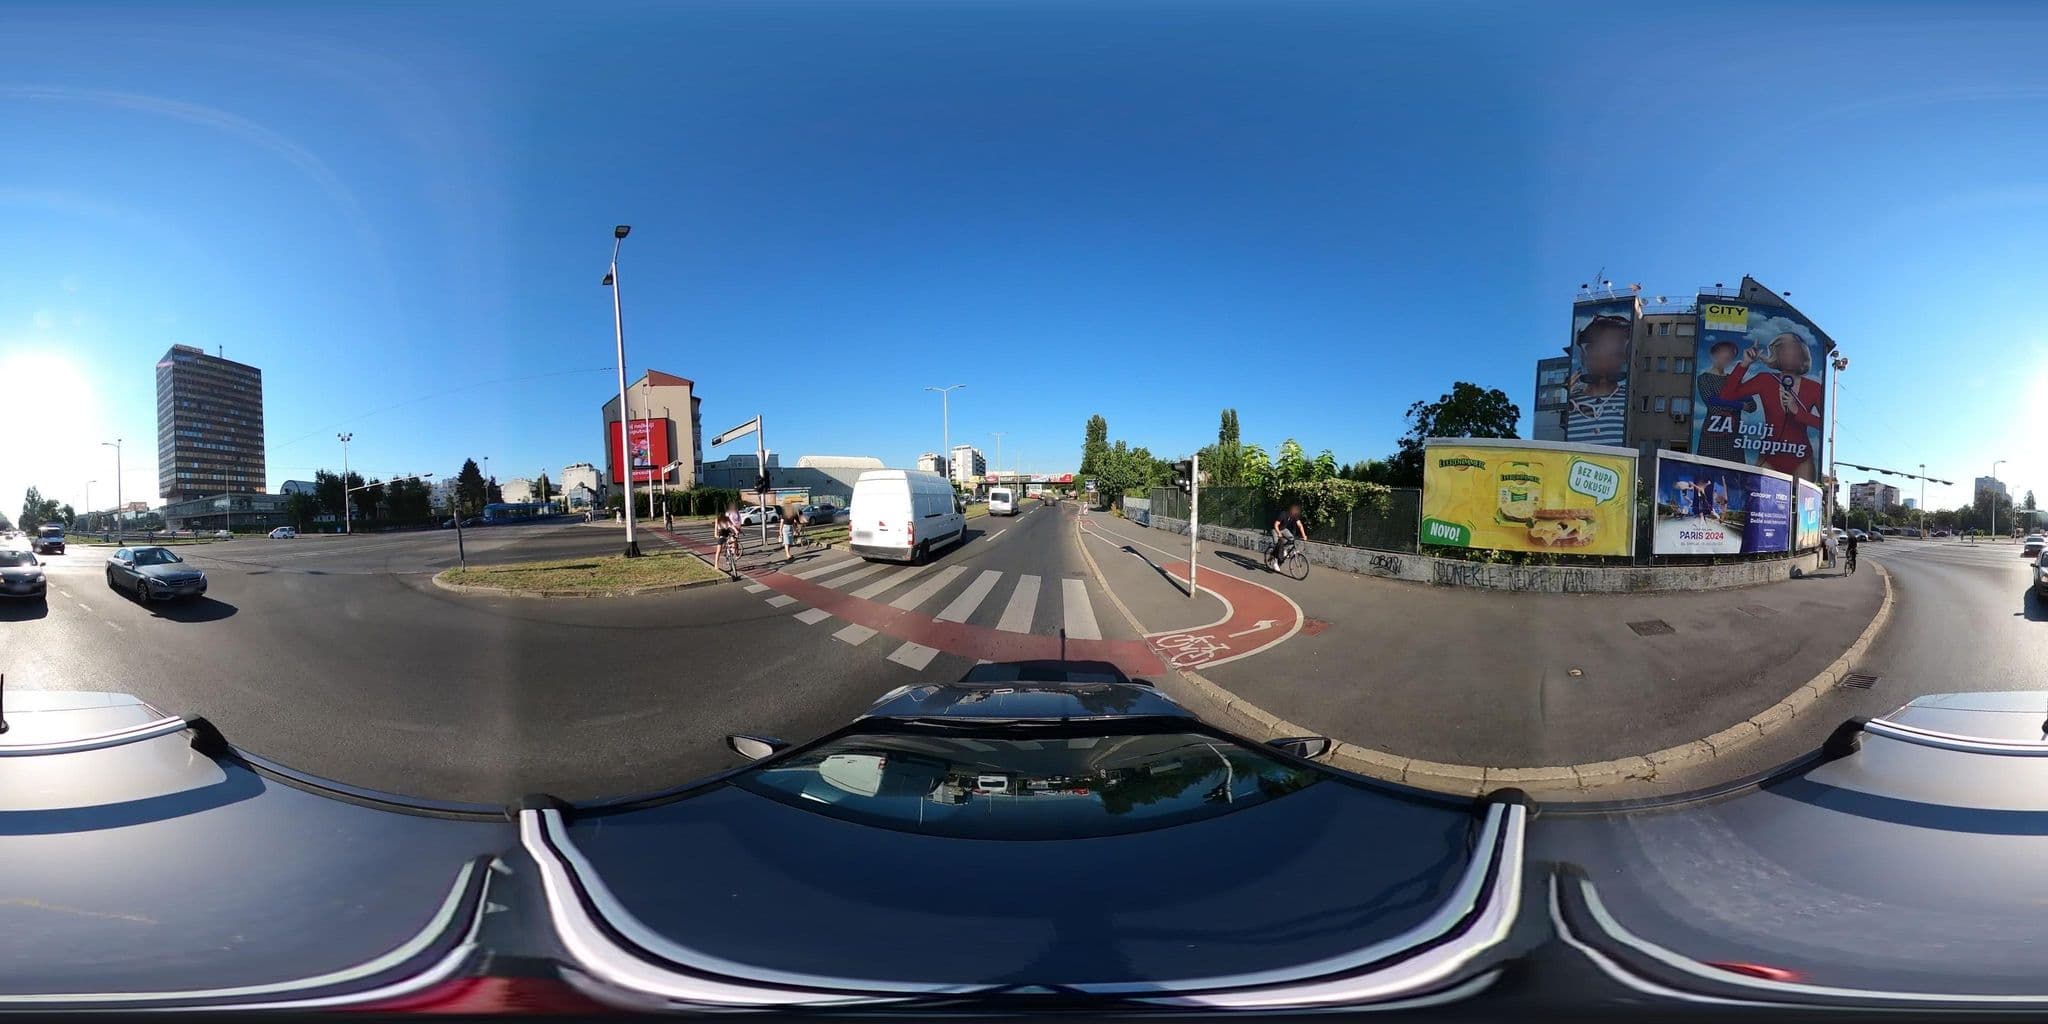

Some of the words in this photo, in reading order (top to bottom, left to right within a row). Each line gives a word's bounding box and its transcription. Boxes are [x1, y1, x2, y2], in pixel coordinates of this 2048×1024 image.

[1709, 305, 1745, 316] CITY
[1707, 415, 1733, 433] ZA
[1738, 420, 1774, 440] bolji
[1733, 435, 1807, 458] shopping
[1577, 465, 1592, 478] BEZ
[1593, 470, 1612, 485] RUPA
[1575, 476, 1582, 487] U
[1583, 479, 1610, 496] OKUSU!
[1430, 521, 1460, 542] NOVO!
[1680, 531, 1703, 540] PARIS
[1705, 531, 1723, 540] 2024
